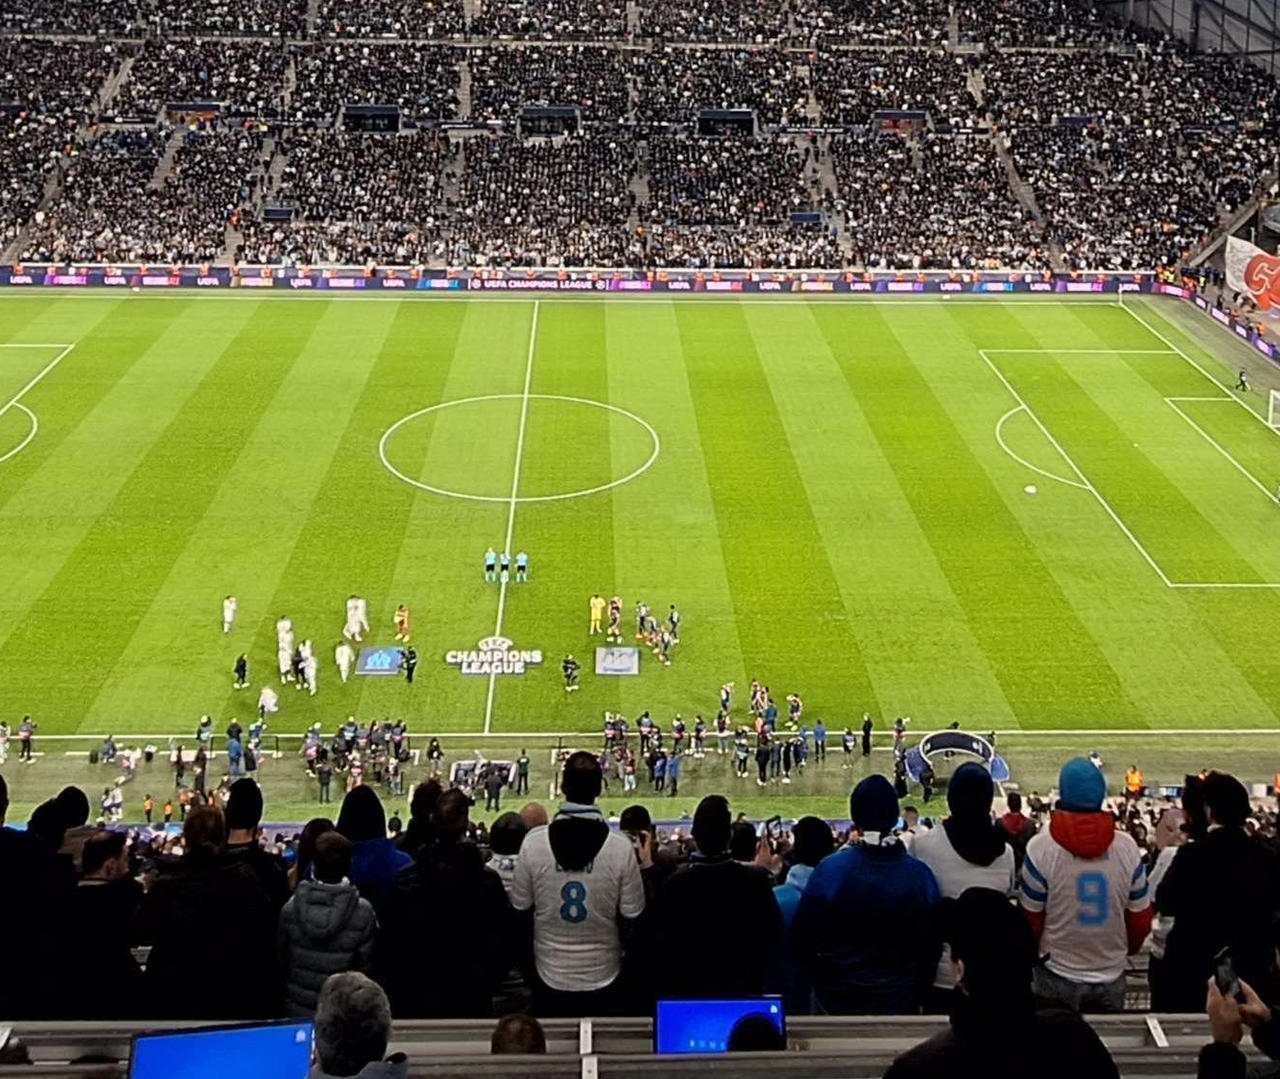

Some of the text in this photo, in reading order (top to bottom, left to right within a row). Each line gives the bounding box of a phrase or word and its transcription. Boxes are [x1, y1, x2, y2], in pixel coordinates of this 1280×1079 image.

[484, 280, 593, 289] UEFA CHAMPIONS LEAGUE
[446, 650, 543, 663] CHAMPIONS
[461, 662, 525, 674] LEAGUE
[561, 881, 587, 923] 8
[1078, 872, 1109, 927] 9
